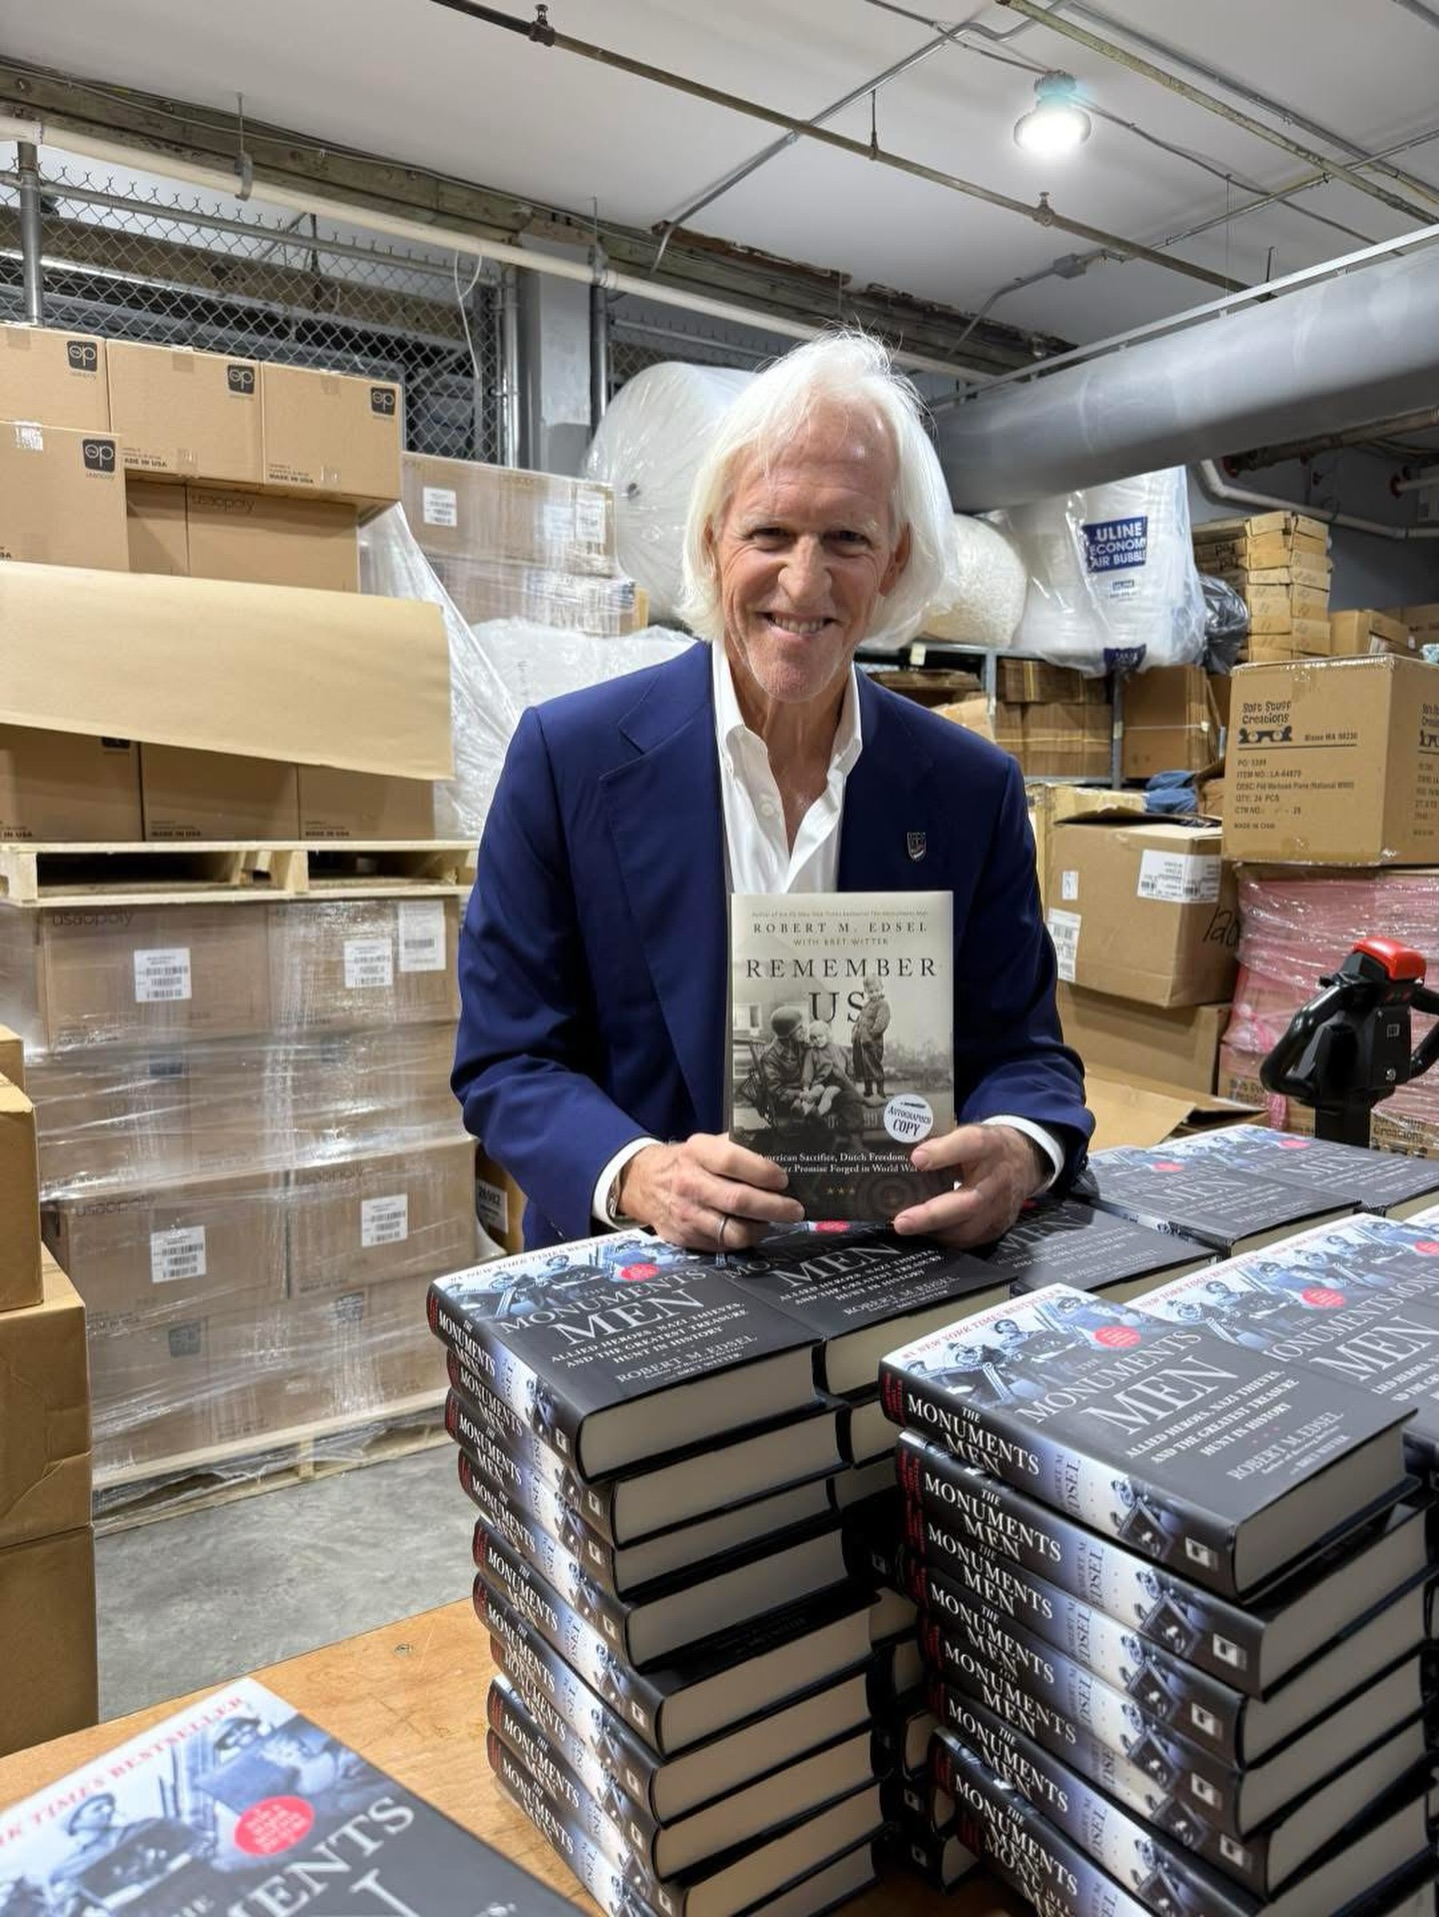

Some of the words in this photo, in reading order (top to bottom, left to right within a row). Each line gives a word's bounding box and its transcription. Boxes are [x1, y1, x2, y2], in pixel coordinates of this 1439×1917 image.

[152, 460, 168, 468] USA
[1090, 538, 1146, 556] ECONOM
[1096, 523, 1143, 542] ULINE
[1242, 712, 1289, 725] Creations
[1243, 702, 1262, 714] Soft
[1265, 700, 1291, 712] Stuff
[1237, 770, 1253, 779] ITEM
[53, 909, 134, 928] usaopoly
[754, 922, 827, 934] ROBERT
[838, 922, 857, 933] M.
[869, 922, 927, 933] EDSEL
[794, 939, 819, 947] WITH
[824, 938, 847, 946] BRET
[851, 938, 889, 946] WITTER
[746, 957, 937, 978] REMEMBER
[808, 990, 866, 1024] US
[892, 1119, 921, 1137] COPY
[794, 1165, 828, 1173] Promise
[830, 1165, 859, 1176] Forged
[861, 1164, 870, 1173] in
[872, 1164, 899, 1173] World
[901, 1165, 918, 1173] War
[799, 1152, 838, 1163] Sacrifice,
[840, 1152, 867, 1162] Dutch
[869, 1152, 909, 1163] Freedom,
[768, 1243, 904, 1288] MEN
[500, 1267, 707, 1335] MONUMENTS
[550, 1288, 705, 1346] MEN
[439, 1309, 496, 1378] MONUMENTS
[551, 1344, 598, 1363] ALLIED
[602, 1328, 657, 1350] HEROES,
[657, 1319, 687, 1333] NAZI
[690, 1302, 745, 1321] THIEVES,
[567, 1355, 594, 1369] AND
[600, 1347, 623, 1360] THE
[625, 1328, 686, 1352] GREATEST
[688, 1308, 749, 1330] TREASURE
[613, 1349, 650, 1364] HUNT
[652, 1341, 670, 1353] IN
[671, 1326, 723, 1346] HISTORY
[919, 1335, 941, 1352] NEW
[942, 1325, 972, 1345] YORK
[970, 1312, 1001, 1332] TIMES
[1309, 1316, 1439, 1381] MEN
[615, 1354, 683, 1383] ROBERT
[686, 1347, 709, 1362] M.
[711, 1334, 759, 1355] EDSEL
[1014, 1330, 1202, 1425] MONUMENTS
[1075, 1357, 1100, 1372] THE
[460, 1364, 523, 1437] MONUMENTS
[962, 1406, 981, 1423] THE
[1082, 1355, 1238, 1436] MEN
[1125, 1433, 1166, 1460] ALLIED
[1166, 1411, 1212, 1440] HEROES,
[1210, 1393, 1240, 1414] NAZI
[1235, 1369, 1286, 1397] THIEVES,
[908, 1392, 1041, 1476] MONUMENTS
[1151, 1447, 1177, 1465] AND
[1177, 1435, 1201, 1452] THE
[1199, 1406, 1251, 1440] GREATEST
[1246, 1378, 1300, 1410] TREASURE
[1201, 1432, 1236, 1457] HUNT
[1231, 1427, 1250, 1438] IN
[1244, 1402, 1293, 1430] HISTORY
[1225, 1443, 1288, 1481] ROBERT
[1280, 1434, 1306, 1447] M.
[1296, 1411, 1344, 1439] EDSEL
[459, 1412, 522, 1486] MONUMENTS
[477, 1447, 506, 1488] MEN
[944, 1432, 1003, 1478] MEN
[472, 1475, 536, 1553] MONUMENTS
[925, 1472, 1062, 1563] MONUMENTS
[981, 1489, 1001, 1505] THE
[962, 1512, 1021, 1562] MEN
[979, 1544, 997, 1561] THE
[488, 1546, 558, 1632] MONUMENTS
[519, 1563, 532, 1579] THE
[928, 1522, 1054, 1620] MONUMENTS
[963, 1564, 1015, 1617] MEN
[507, 1583, 540, 1629] MEN
[981, 1604, 1000, 1624] THE
[488, 1602, 556, 1693] MONUMENTS
[931, 1581, 1055, 1685] MONUMENTS
[966, 1625, 1019, 1678] MEN
[504, 1650, 567, 1741] MONUMENTS
[945, 1640, 1077, 1746] MONUMENTS
[982, 1683, 1036, 1738] MEN
[32, 1777, 106, 1826] TIMES
[109, 1695, 245, 1778] BESTSELLER
[504, 1714, 580, 1809] MONUMENTS
[536, 1735, 549, 1751] THE
[949, 1697, 1069, 1813] MONUMENTS
[1000, 1727, 1017, 1746] THE
[525, 1754, 559, 1801] MEN
[532, 1782, 544, 1798] THE
[982, 1746, 1033, 1801] MEN
[503, 1758, 574, 1855] MONUMENTS
[1006, 1805, 1026, 1825] THE
[955, 1773, 1079, 1897] MONUMENTS
